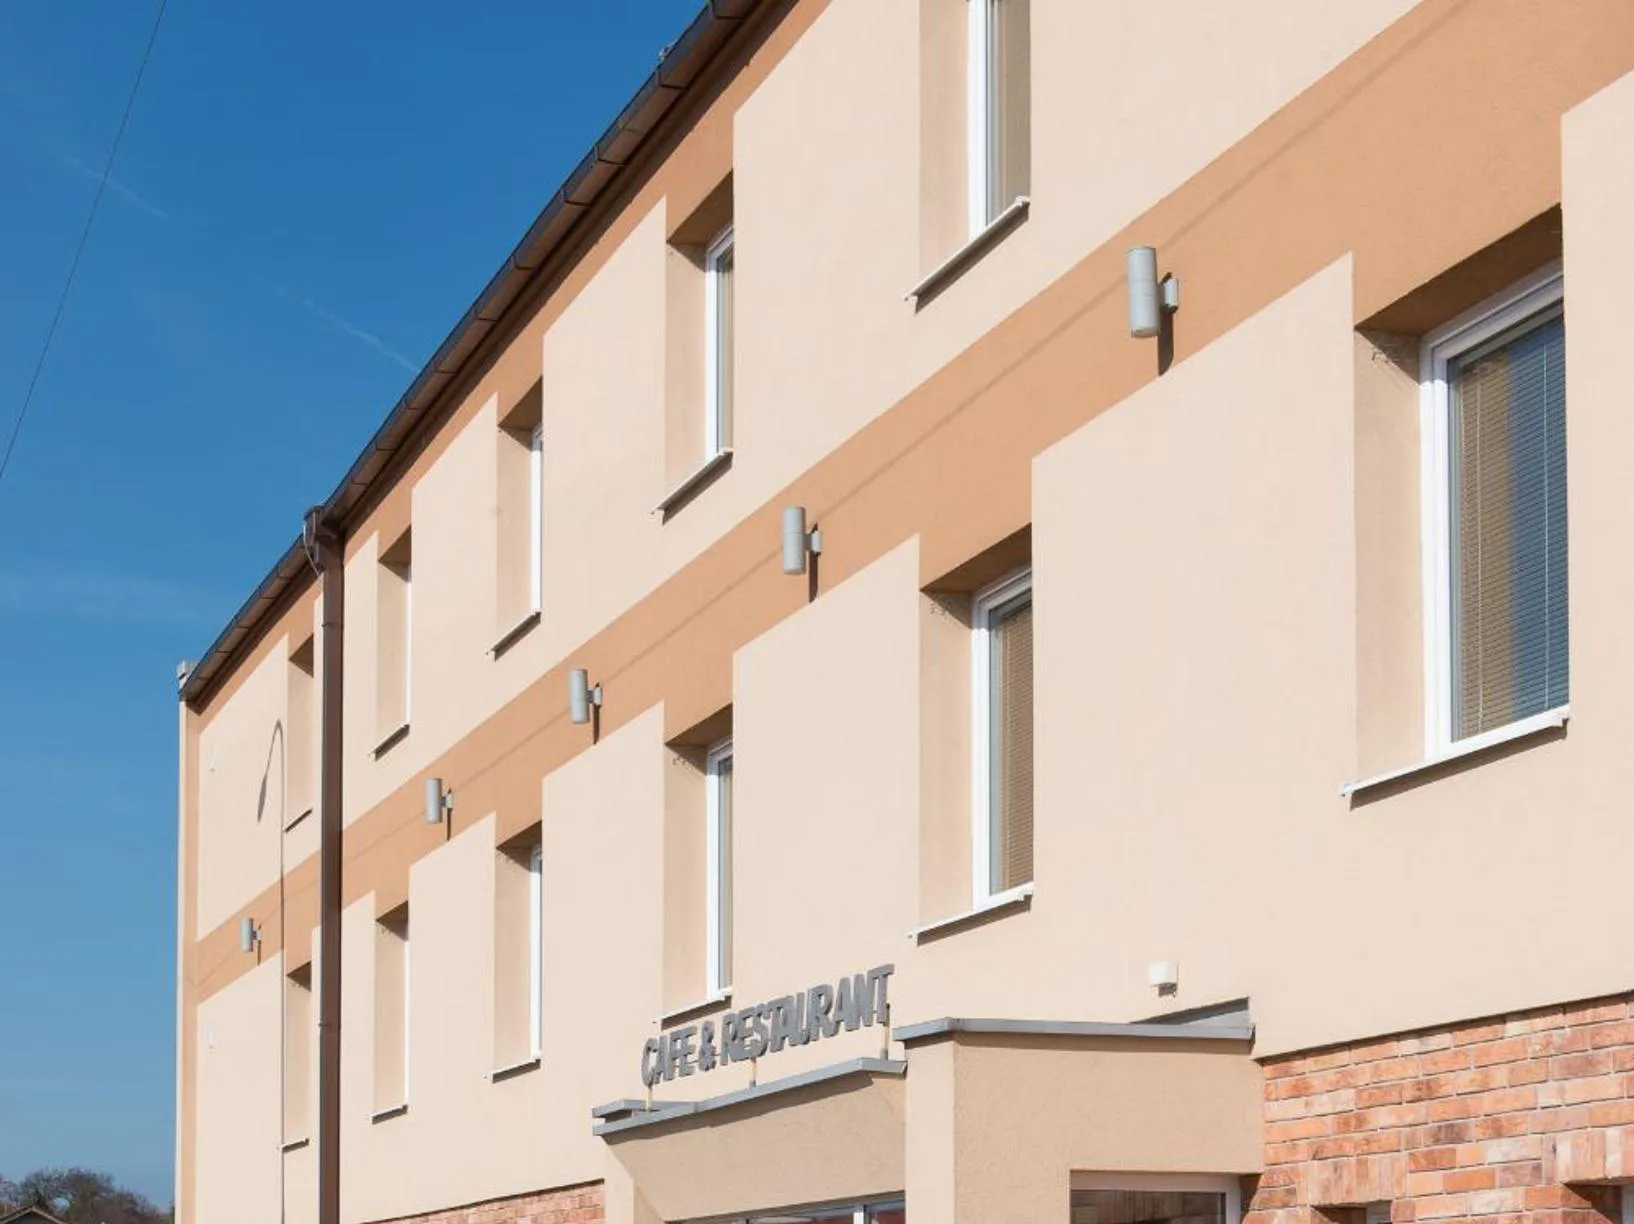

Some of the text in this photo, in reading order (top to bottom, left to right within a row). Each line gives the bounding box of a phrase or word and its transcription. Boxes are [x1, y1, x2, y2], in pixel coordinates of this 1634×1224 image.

[641, 963, 895, 1086] CAFE & RESTAURANT
